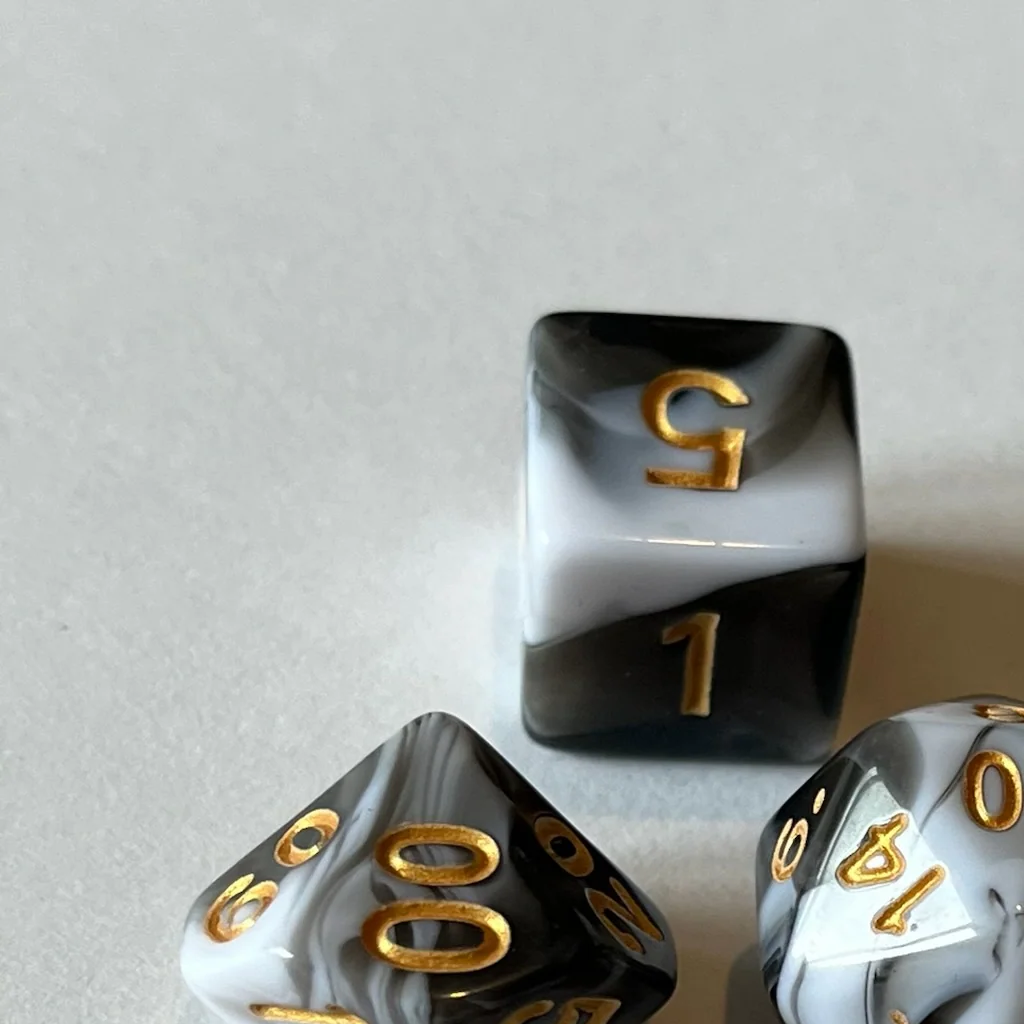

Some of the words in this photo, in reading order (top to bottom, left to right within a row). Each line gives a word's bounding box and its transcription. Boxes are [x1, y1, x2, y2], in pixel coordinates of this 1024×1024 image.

[641, 368, 749, 491] 5
[661, 612, 720, 717] 1
[835, 811, 946, 936] 14
